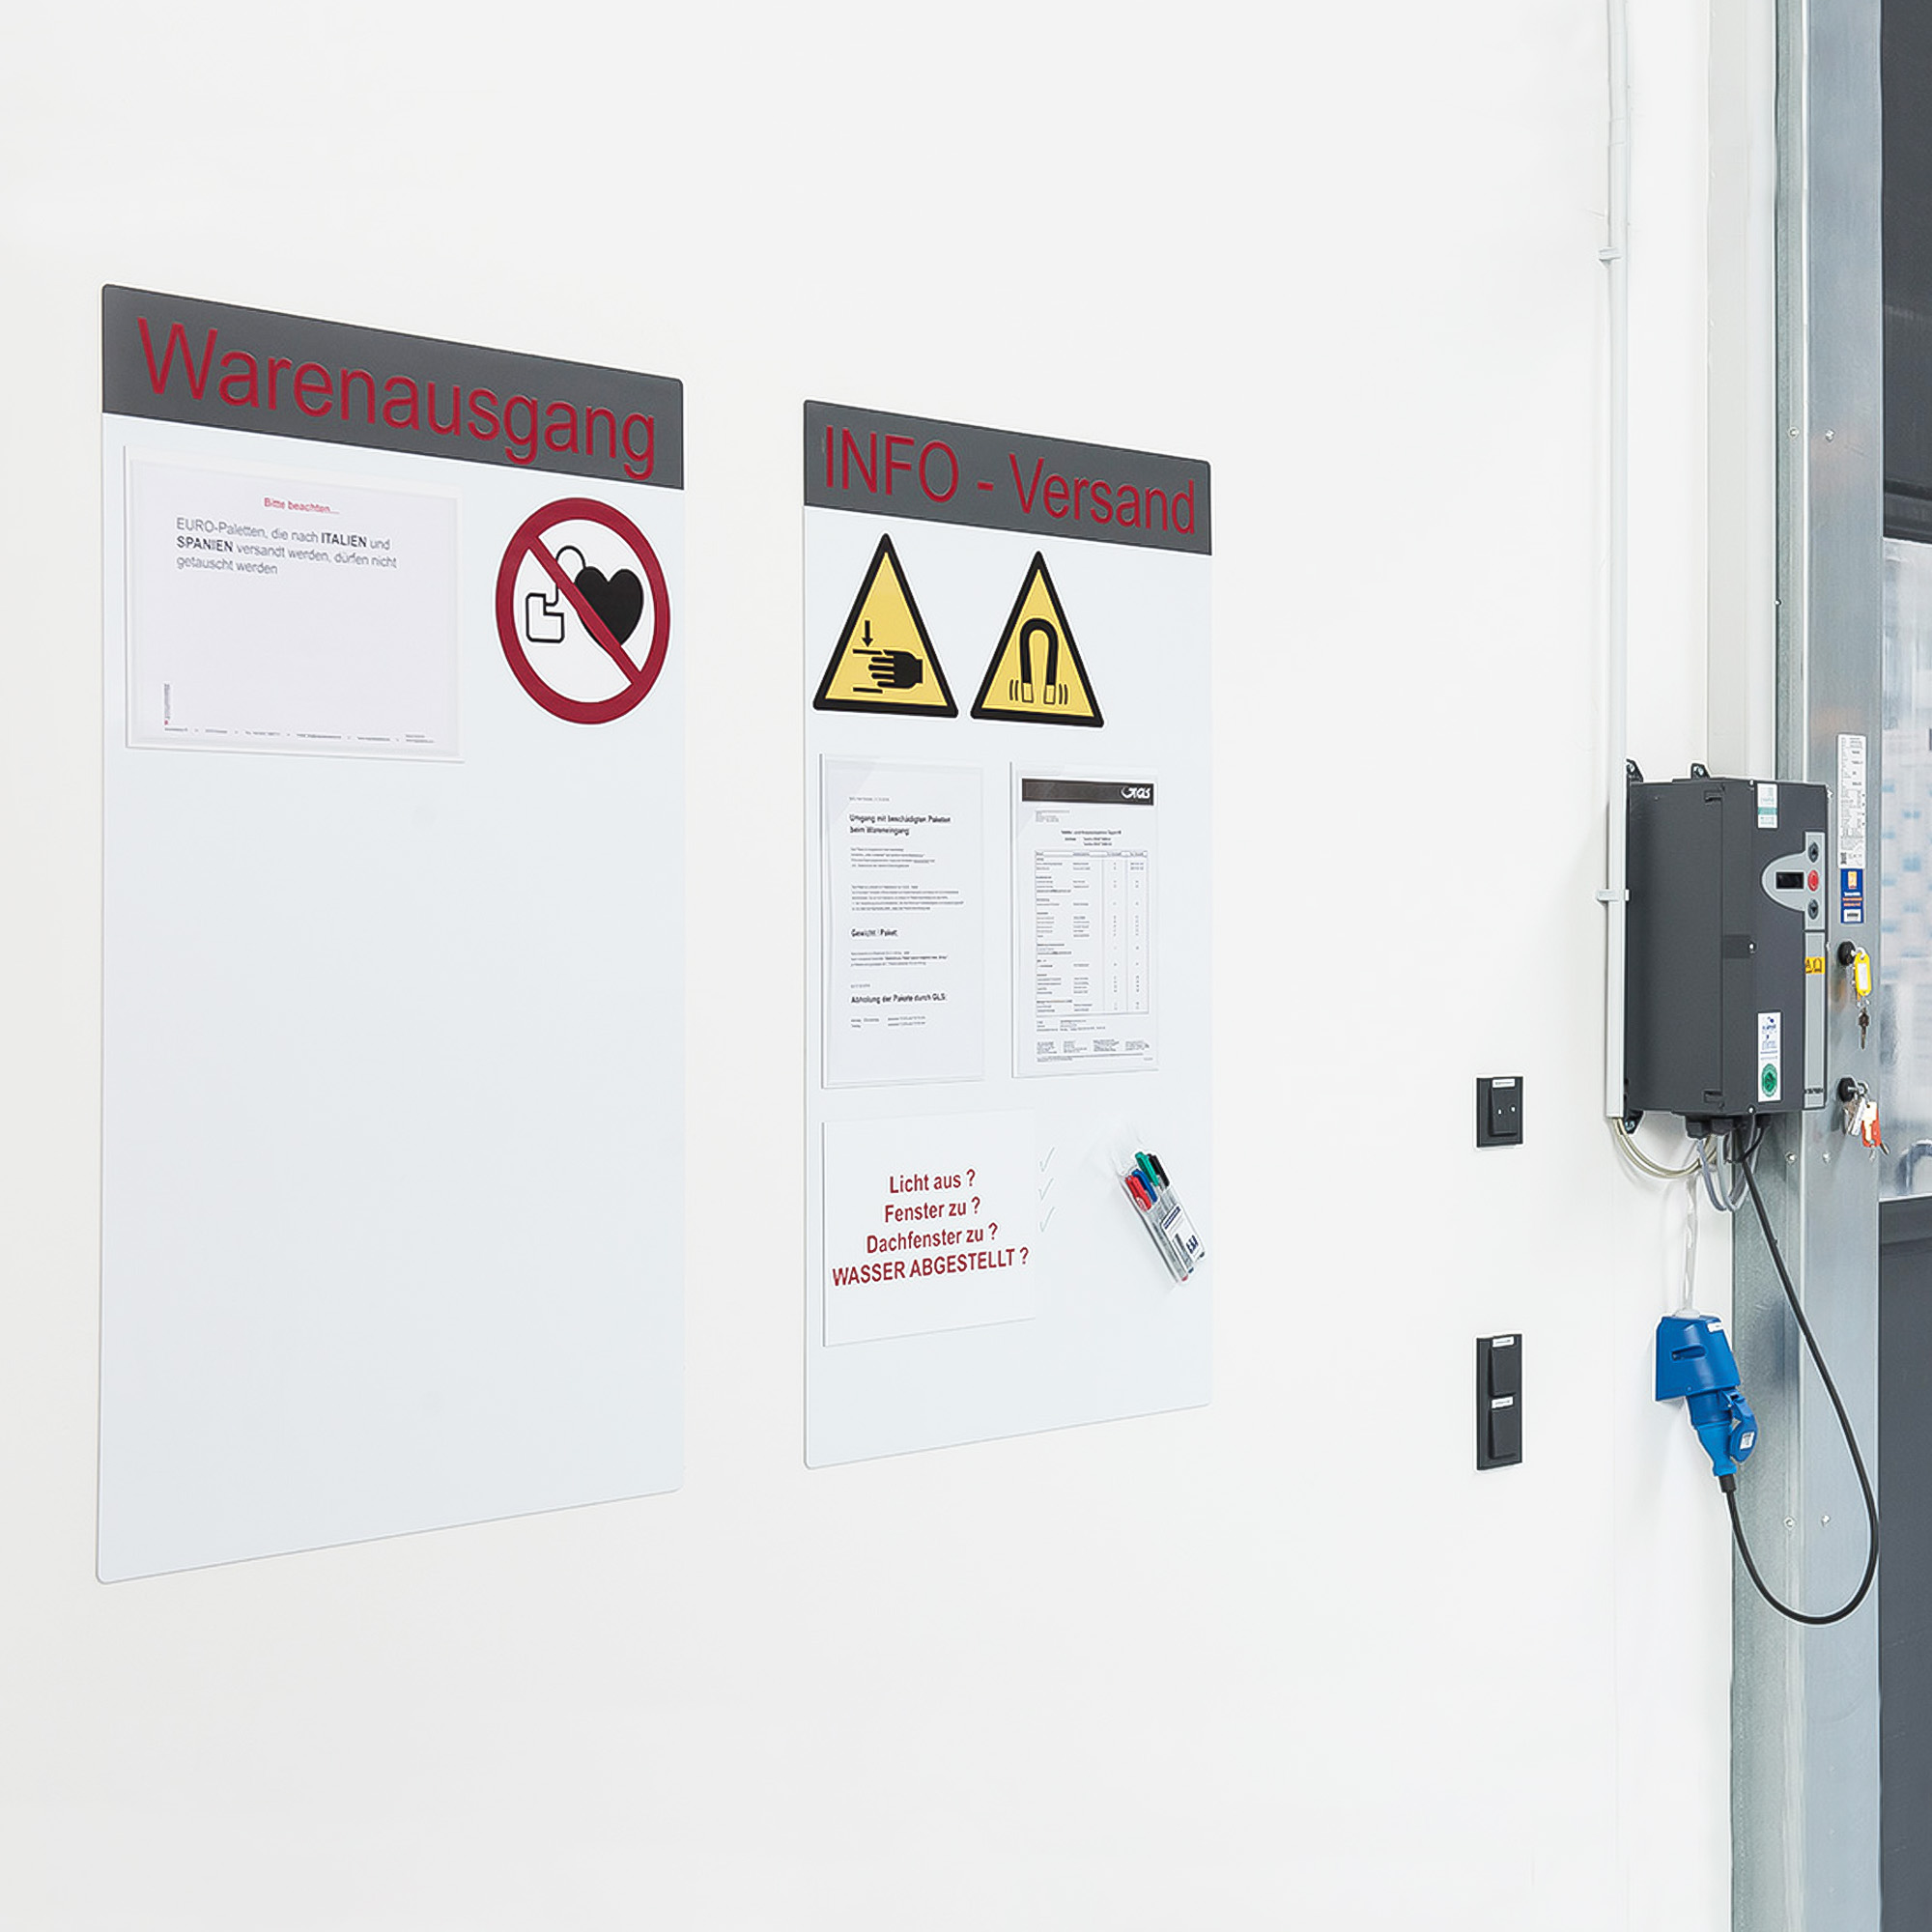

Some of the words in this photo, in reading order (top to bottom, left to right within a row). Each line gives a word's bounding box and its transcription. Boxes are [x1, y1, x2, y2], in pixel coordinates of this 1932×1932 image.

[137, 317, 655, 481] Warenausgang
[826, 425, 959, 502] INFO
[977, 480, 994, 491] -
[1009, 453, 1195, 535] Versand
[264, 497, 285, 510] Bitte
[176, 517, 268, 540] EURO-Paletten,
[271, 527, 288, 540] die
[292, 530, 318, 544] nach
[321, 532, 367, 548] ITALIEN
[370, 538, 390, 550] und
[176, 535, 233, 553] SPANIEN
[237, 543, 285, 558] versandt
[290, 549, 330, 563] werden,
[334, 552, 369, 566] dürfen
[372, 554, 397, 568] nicht
[177, 555, 234, 571] getauscht
[237, 559, 278, 575] werden
[890, 1172, 929, 1193] Licht
[934, 1174, 961, 1190] aus
[967, 1169, 976, 1187] ?
[885, 1202, 945, 1223] Fenster
[949, 1202, 967, 1217] zu
[971, 1196, 980, 1214] ?
[867, 1230, 962, 1254] Dachfenster
[966, 1228, 984, 1243] zu
[988, 1222, 998, 1240] ?
[832, 1262, 906, 1287] WASSER
[909, 1248, 1014, 1278] ABGESTELLT
[1020, 1246, 1029, 1265] ?
